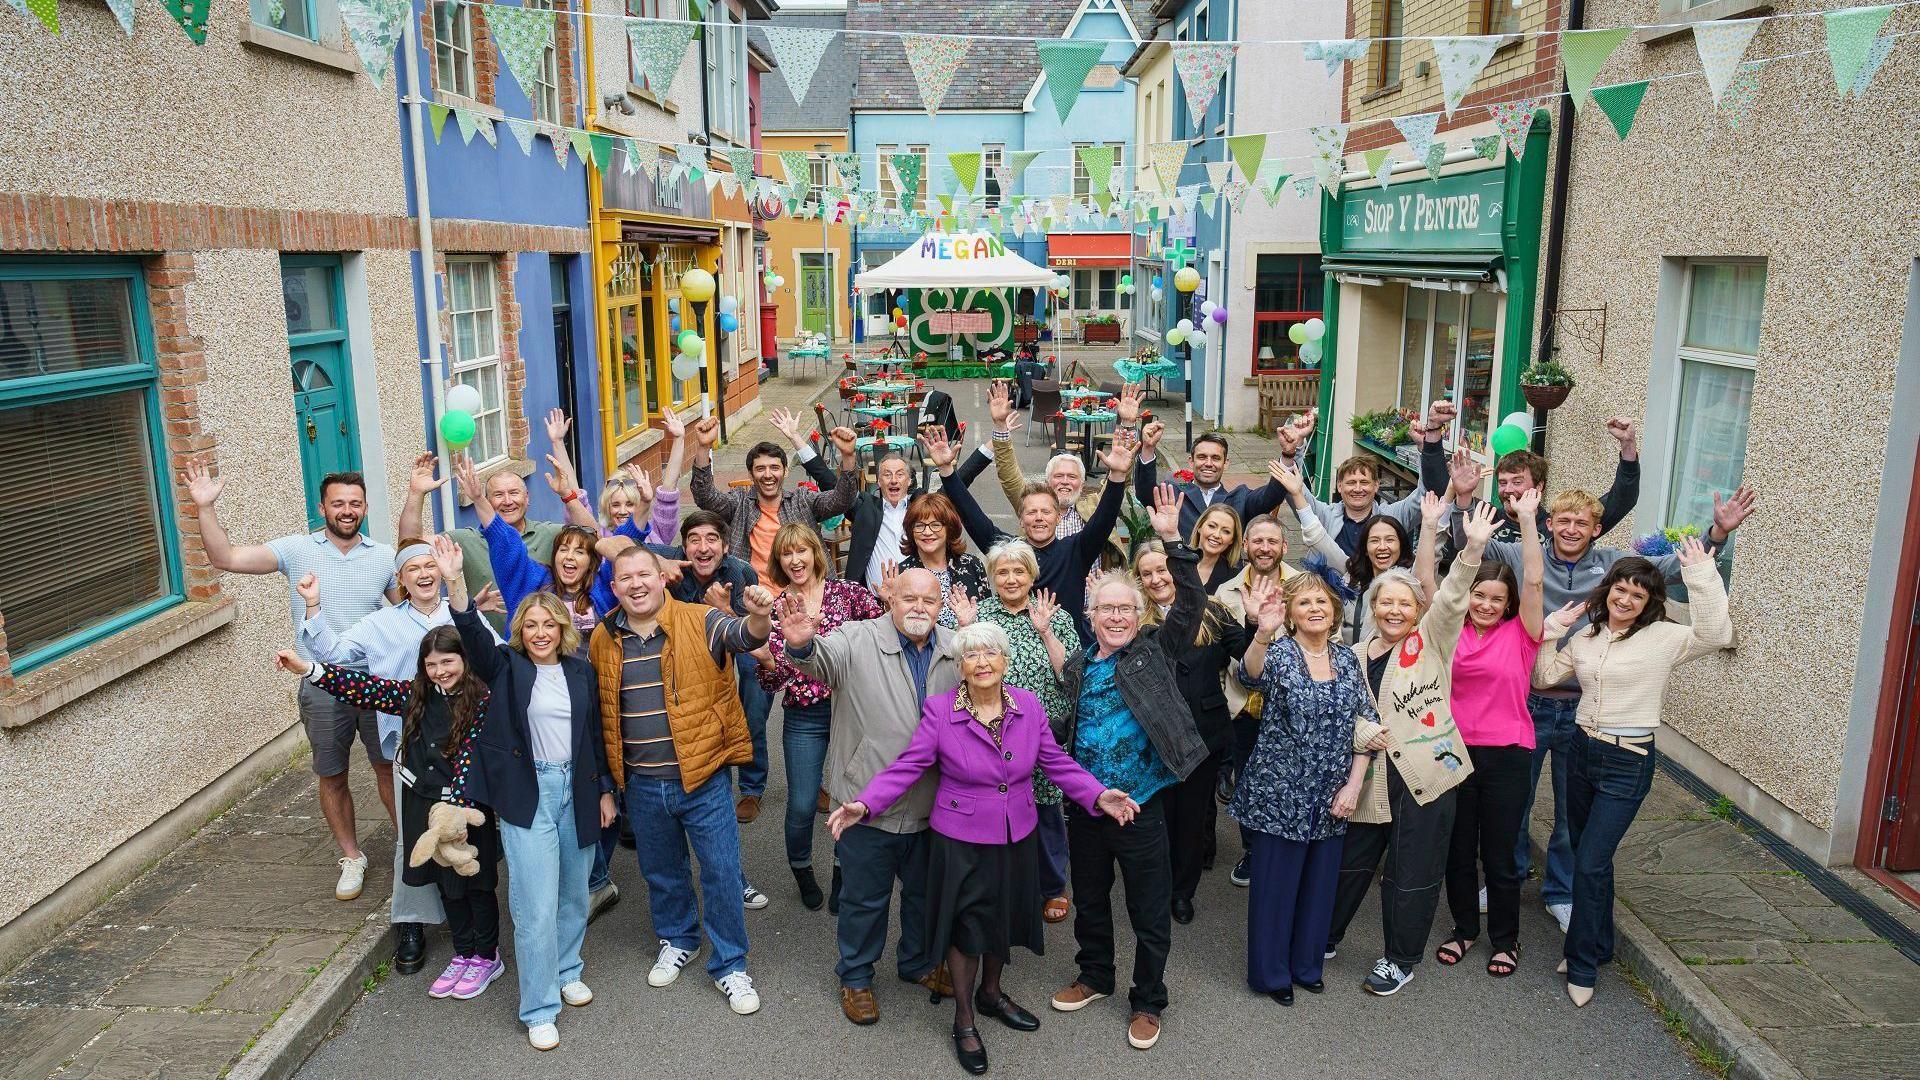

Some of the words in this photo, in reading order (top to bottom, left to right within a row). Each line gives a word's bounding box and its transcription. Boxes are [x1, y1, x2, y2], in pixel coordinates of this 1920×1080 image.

[1364, 199, 1394, 233] SIOP
[1399, 195, 1411, 231] Y
[1414, 193, 1480, 231] PENTRE
[921, 235, 1005, 260] MEGAN
[1055, 258, 1077, 266] DERI
[910, 286, 1012, 354] 80
[1407, 707, 1423, 719] Max
